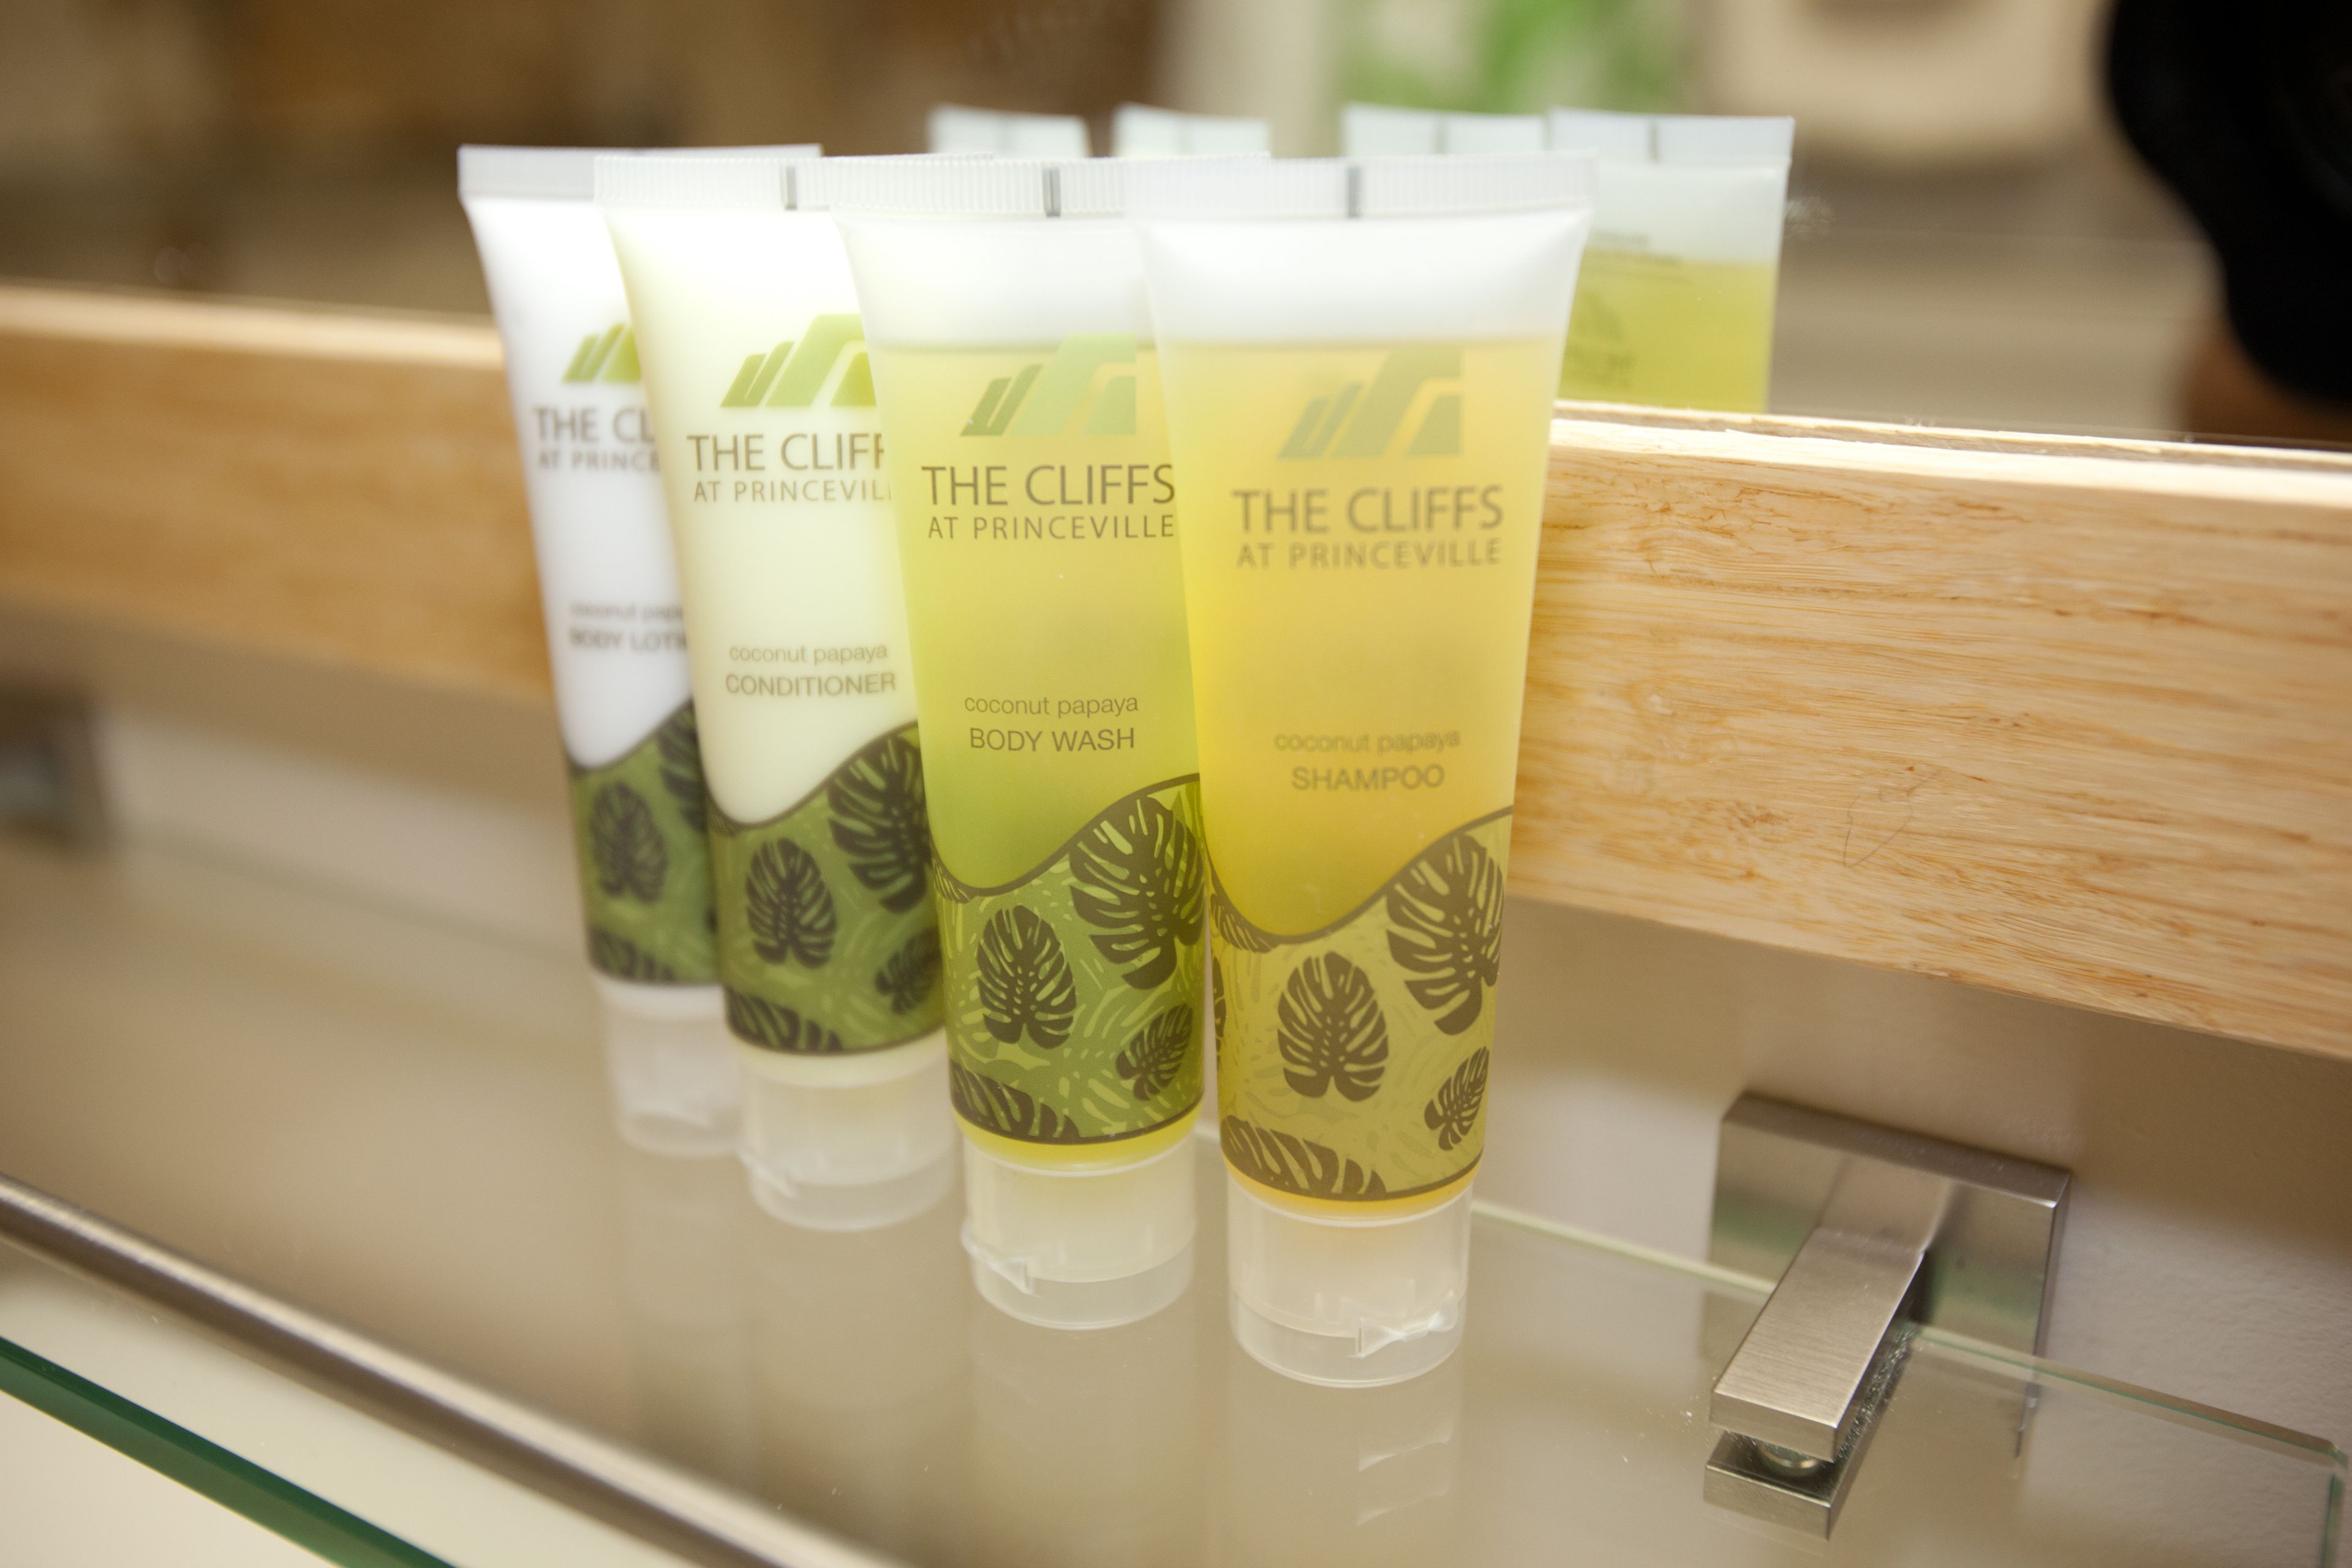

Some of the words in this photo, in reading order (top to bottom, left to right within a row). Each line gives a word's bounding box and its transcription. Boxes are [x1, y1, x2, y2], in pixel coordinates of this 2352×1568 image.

[532, 405, 599, 442] THE
[539, 451, 559, 471] AT
[687, 434, 765, 471] THE
[694, 480, 722, 502] AT
[734, 479, 892, 502] PRINCEVIL
[921, 466, 1008, 506] THE
[1025, 464, 1175, 505] CLIFFS
[1231, 488, 1330, 535] THE
[1346, 484, 1504, 534] CLIFFS
[928, 516, 959, 540] AT
[974, 514, 1175, 540] PRINCEVILLE
[1235, 541, 1273, 570] AT
[1289, 537, 1502, 570] PRINCEVILLE
[729, 646, 807, 662] coconut
[813, 644, 888, 666] papaya
[725, 672, 897, 697] CONDITIONER
[964, 697, 1050, 715] coconut
[1058, 696, 1139, 719] papaya
[970, 727, 1043, 752] BODY
[1051, 727, 1134, 752] WASH
[1273, 732, 1370, 754] coconut
[1377, 729, 1461, 757] papaya
[1291, 763, 1446, 792] SHAMPOO
